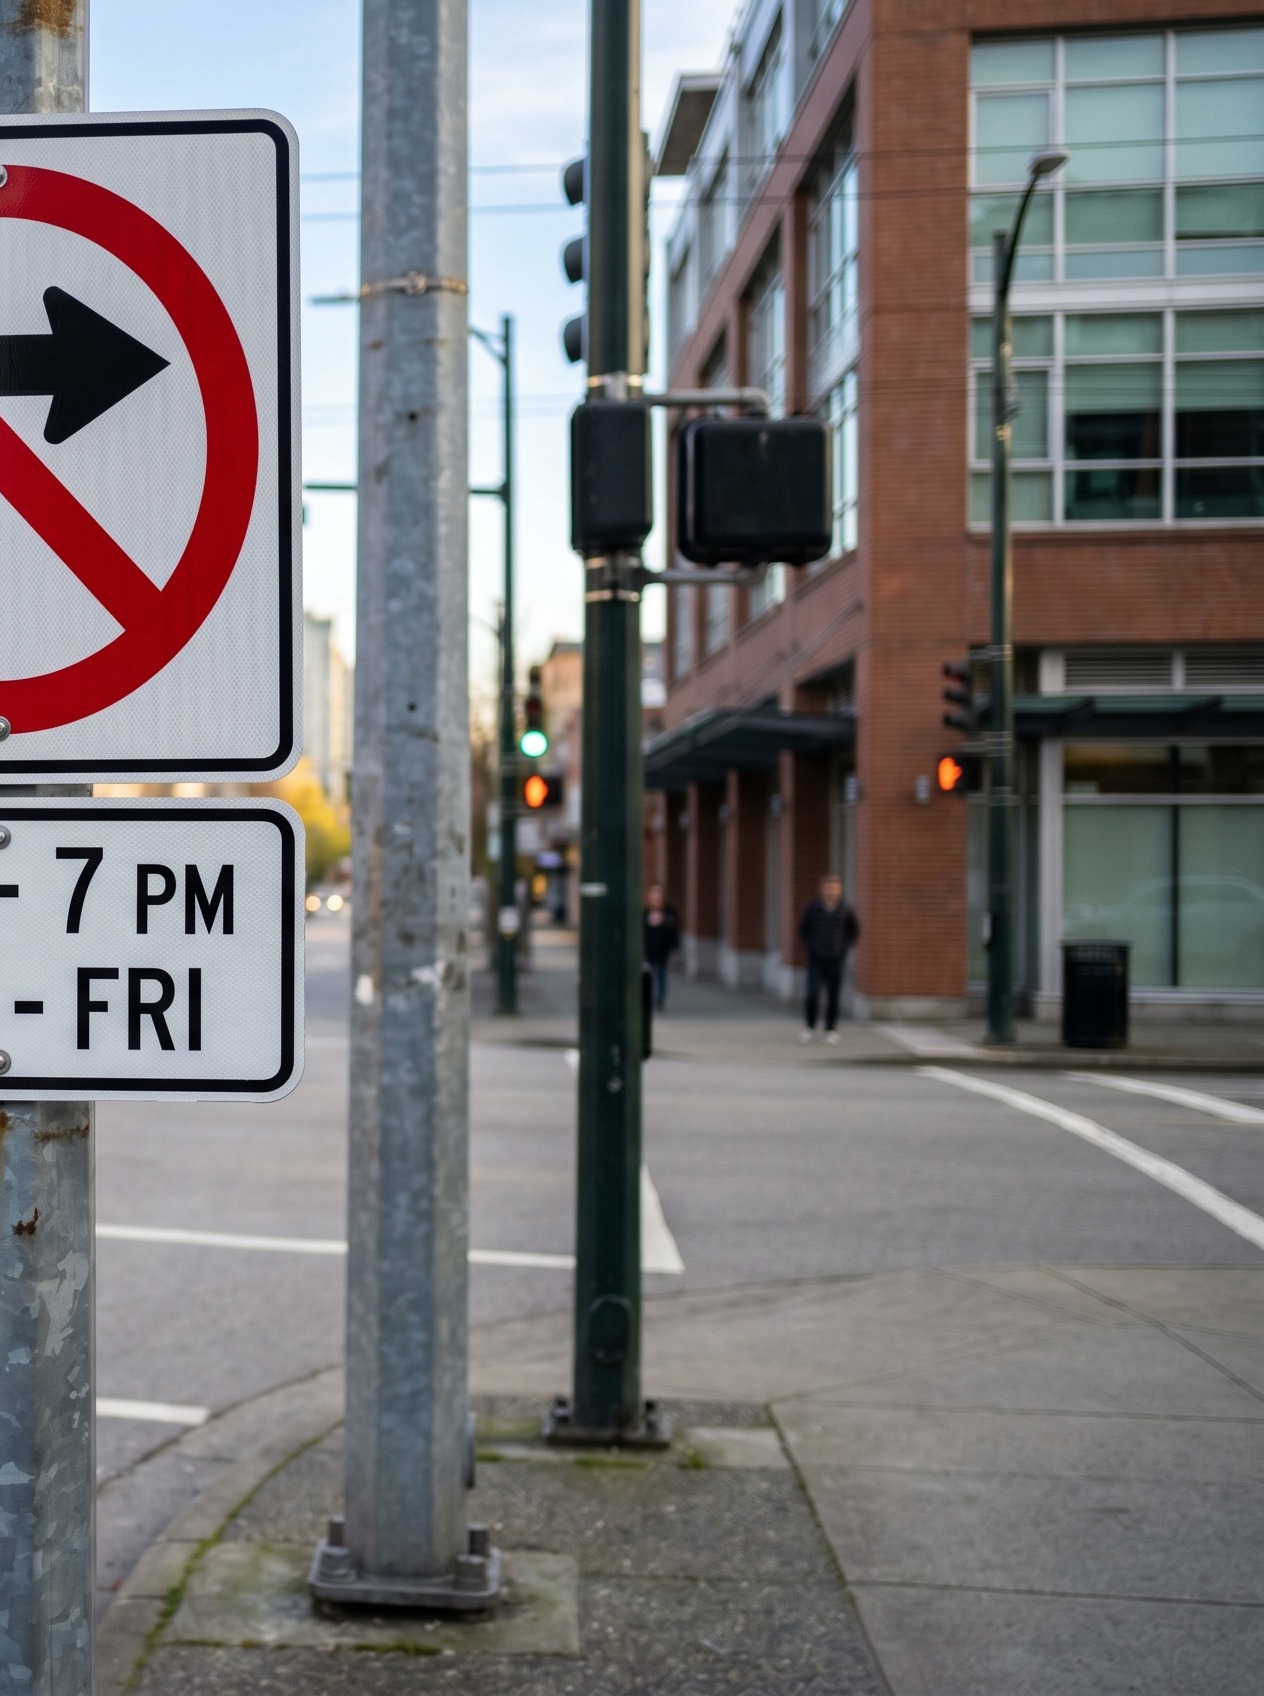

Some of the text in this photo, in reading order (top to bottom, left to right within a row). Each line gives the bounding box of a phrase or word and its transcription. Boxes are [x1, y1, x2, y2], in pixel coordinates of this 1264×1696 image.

[55, 846, 104, 934] 7
[136, 863, 234, 935] PM
[14, 1000, 44, 1015] -
[76, 966, 202, 1052] FRI
